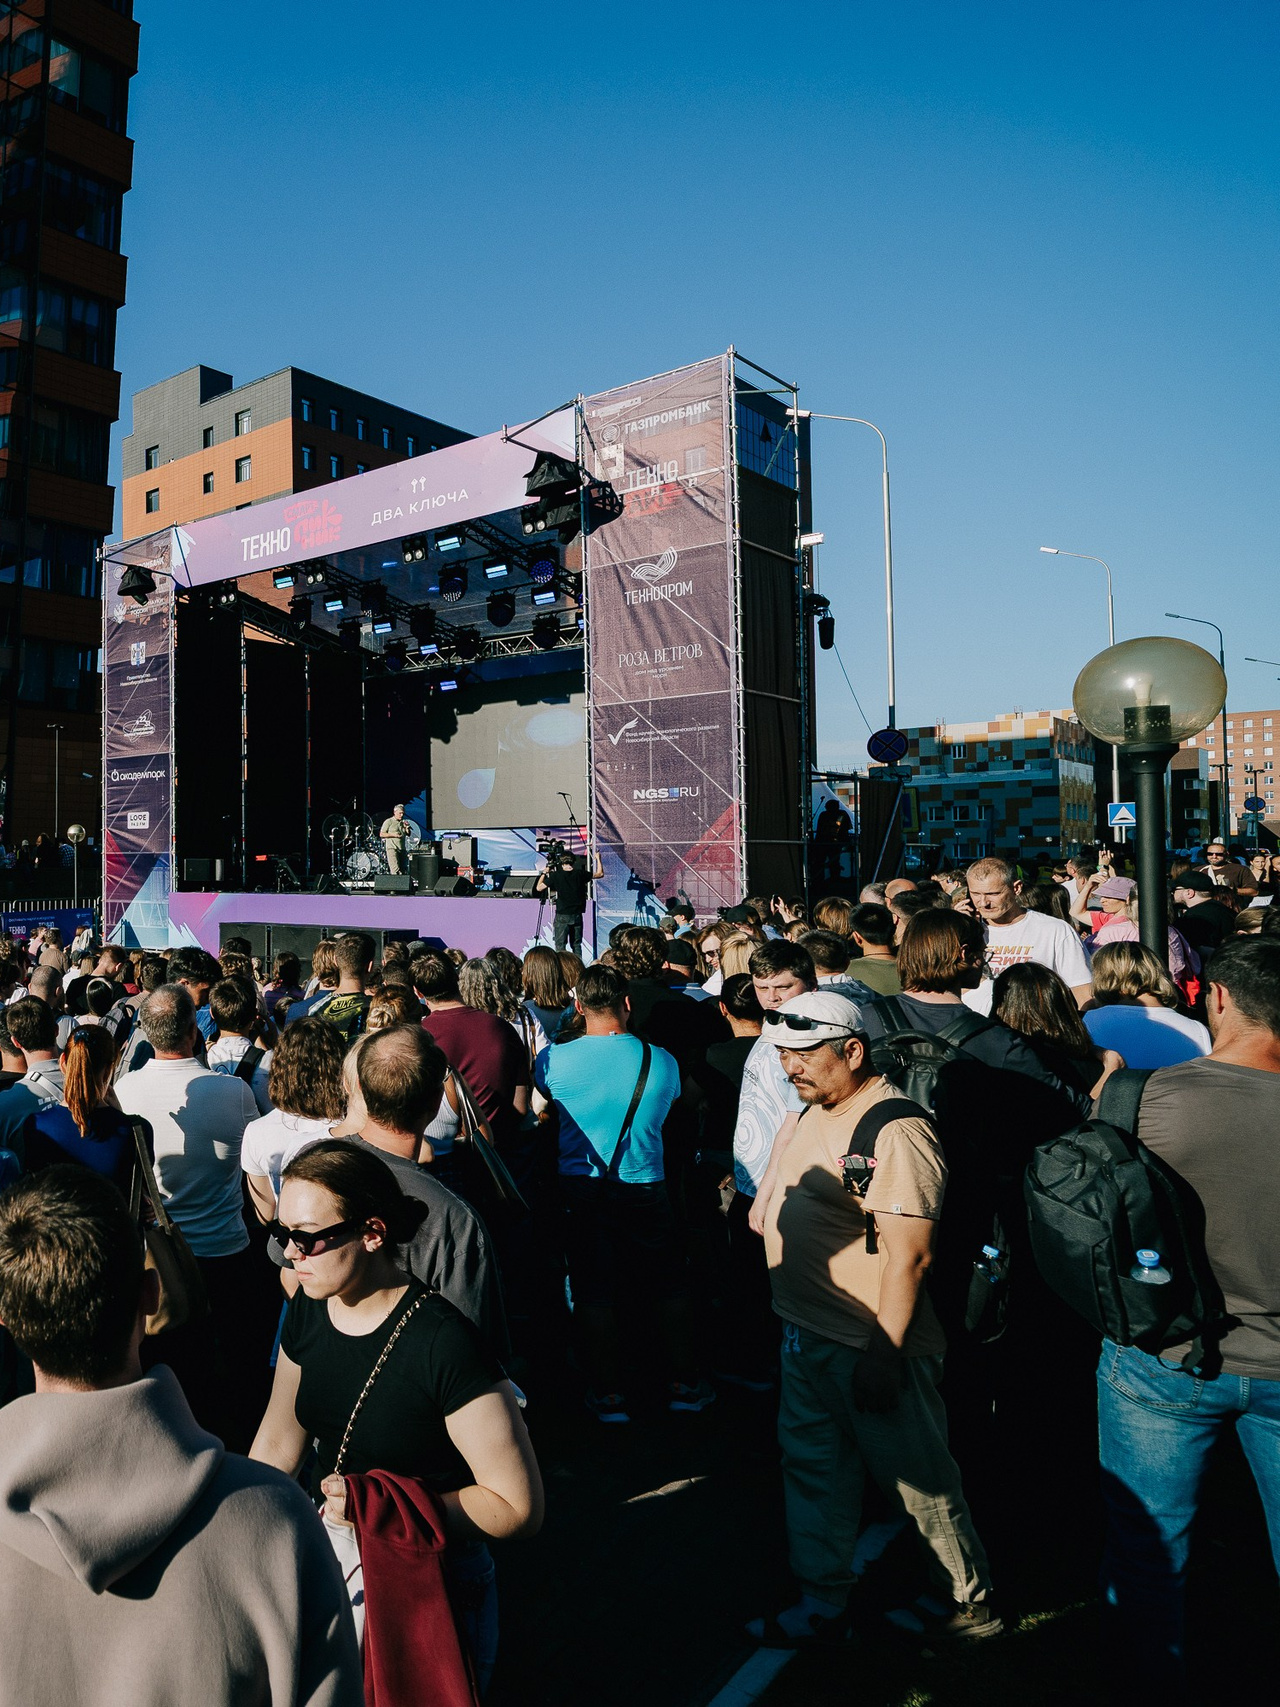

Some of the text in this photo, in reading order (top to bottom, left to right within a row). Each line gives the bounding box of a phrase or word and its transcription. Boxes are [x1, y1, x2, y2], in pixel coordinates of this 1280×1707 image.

[625, 400, 712, 435] ГАЗПРОМБАНК
[371, 488, 469, 527] ДВА КЛЮЧА
[241, 526, 291, 562] ТЕХНО
[624, 580, 693, 606] ТЕХНОПРОМ
[618, 643, 703, 668] РОЗА ВЕТРОВ
